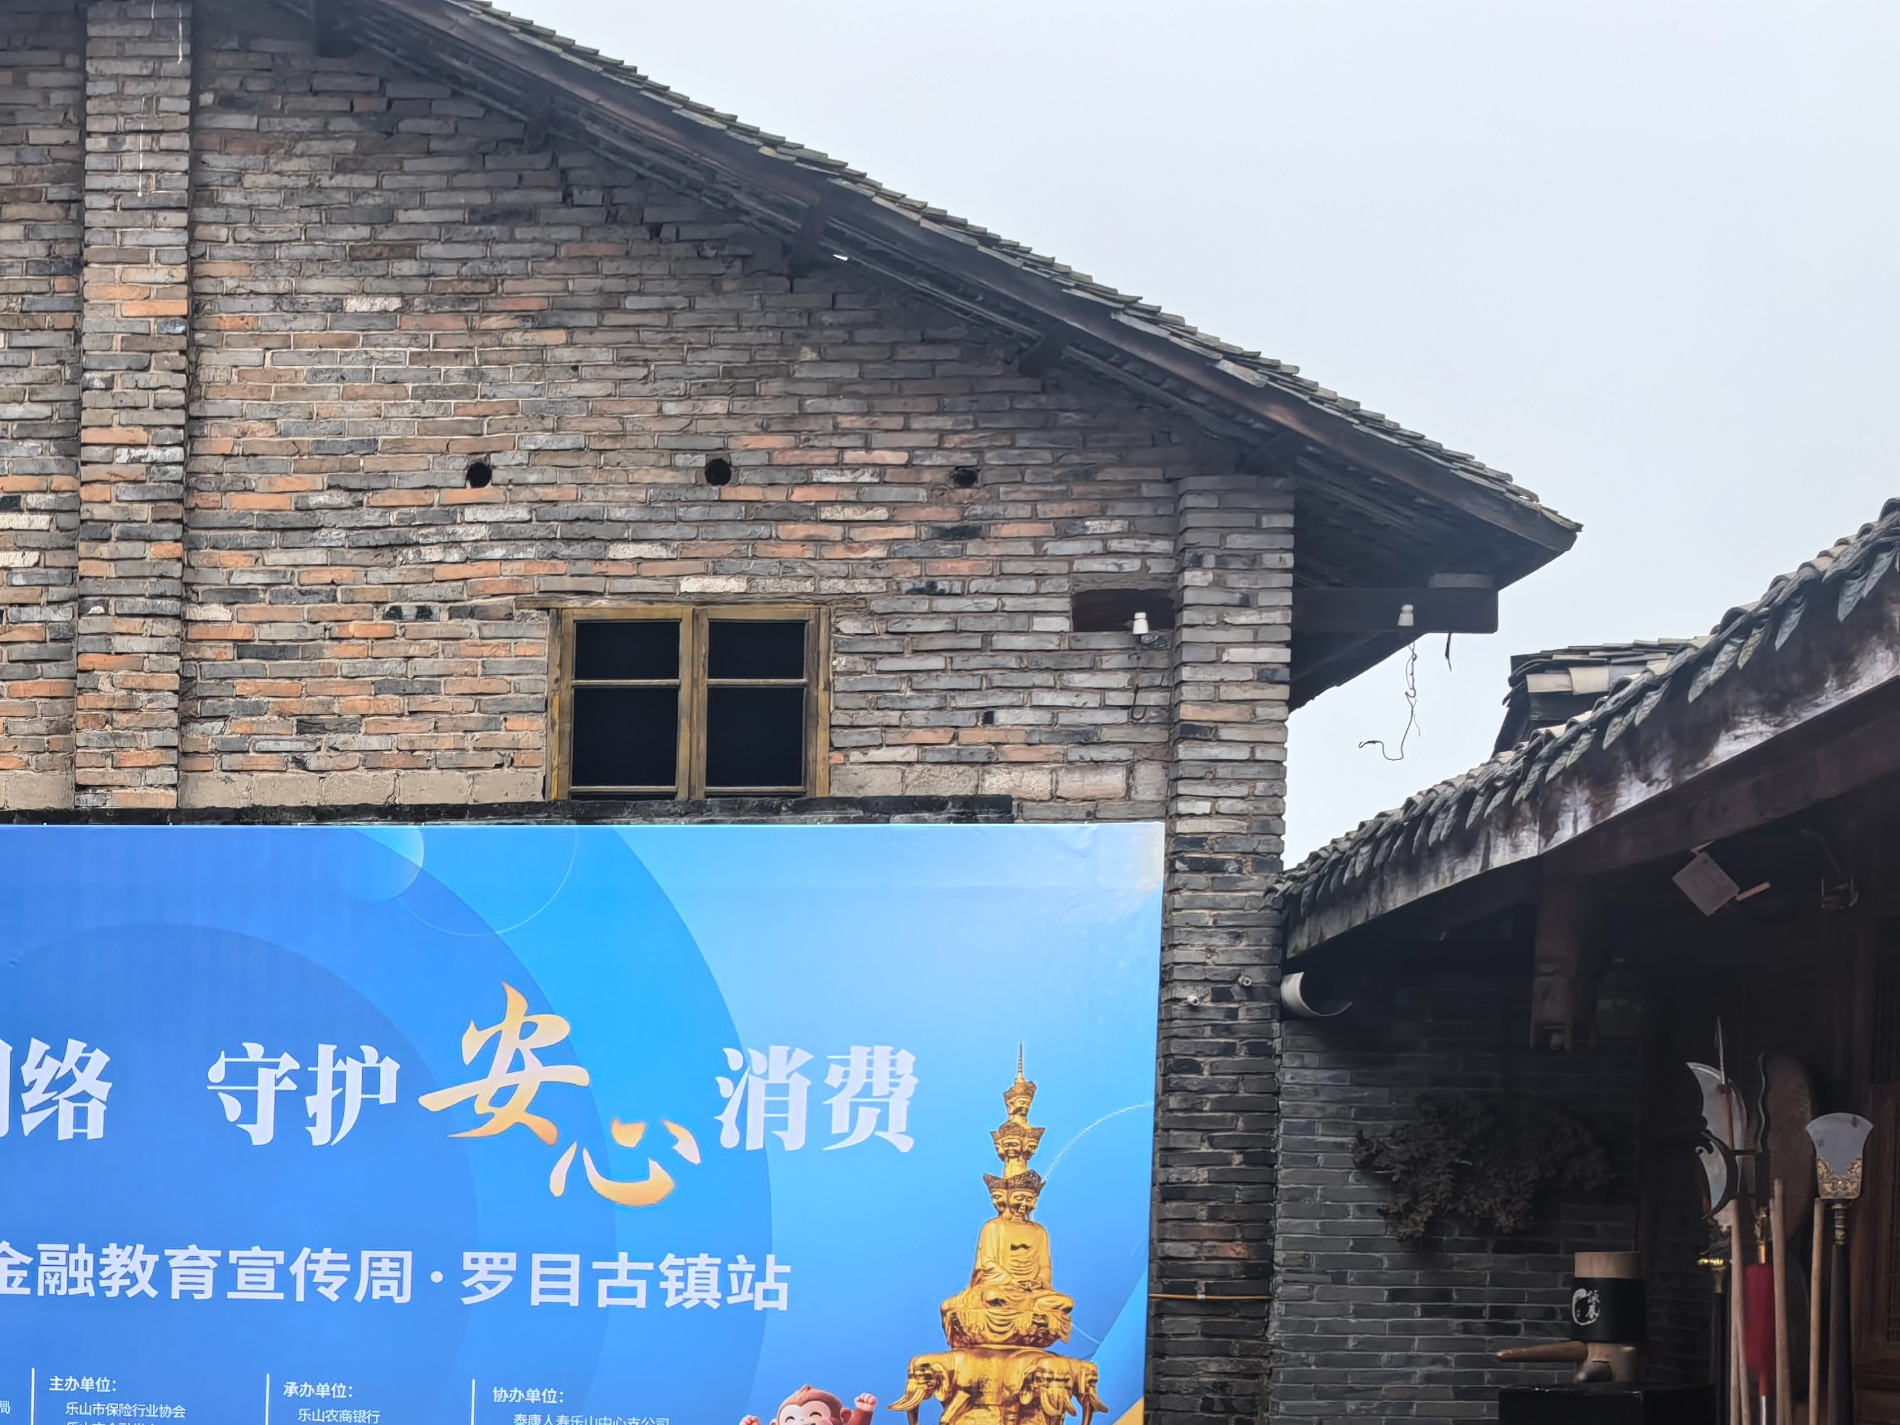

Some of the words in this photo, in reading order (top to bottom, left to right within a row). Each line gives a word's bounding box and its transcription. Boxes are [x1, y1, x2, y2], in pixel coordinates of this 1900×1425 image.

[206, 981, 919, 1207] 守护安心消费
[65, 1401, 186, 1419] 乐山市保险行业协会
[297, 1407, 381, 1424] 乐山农商银行
